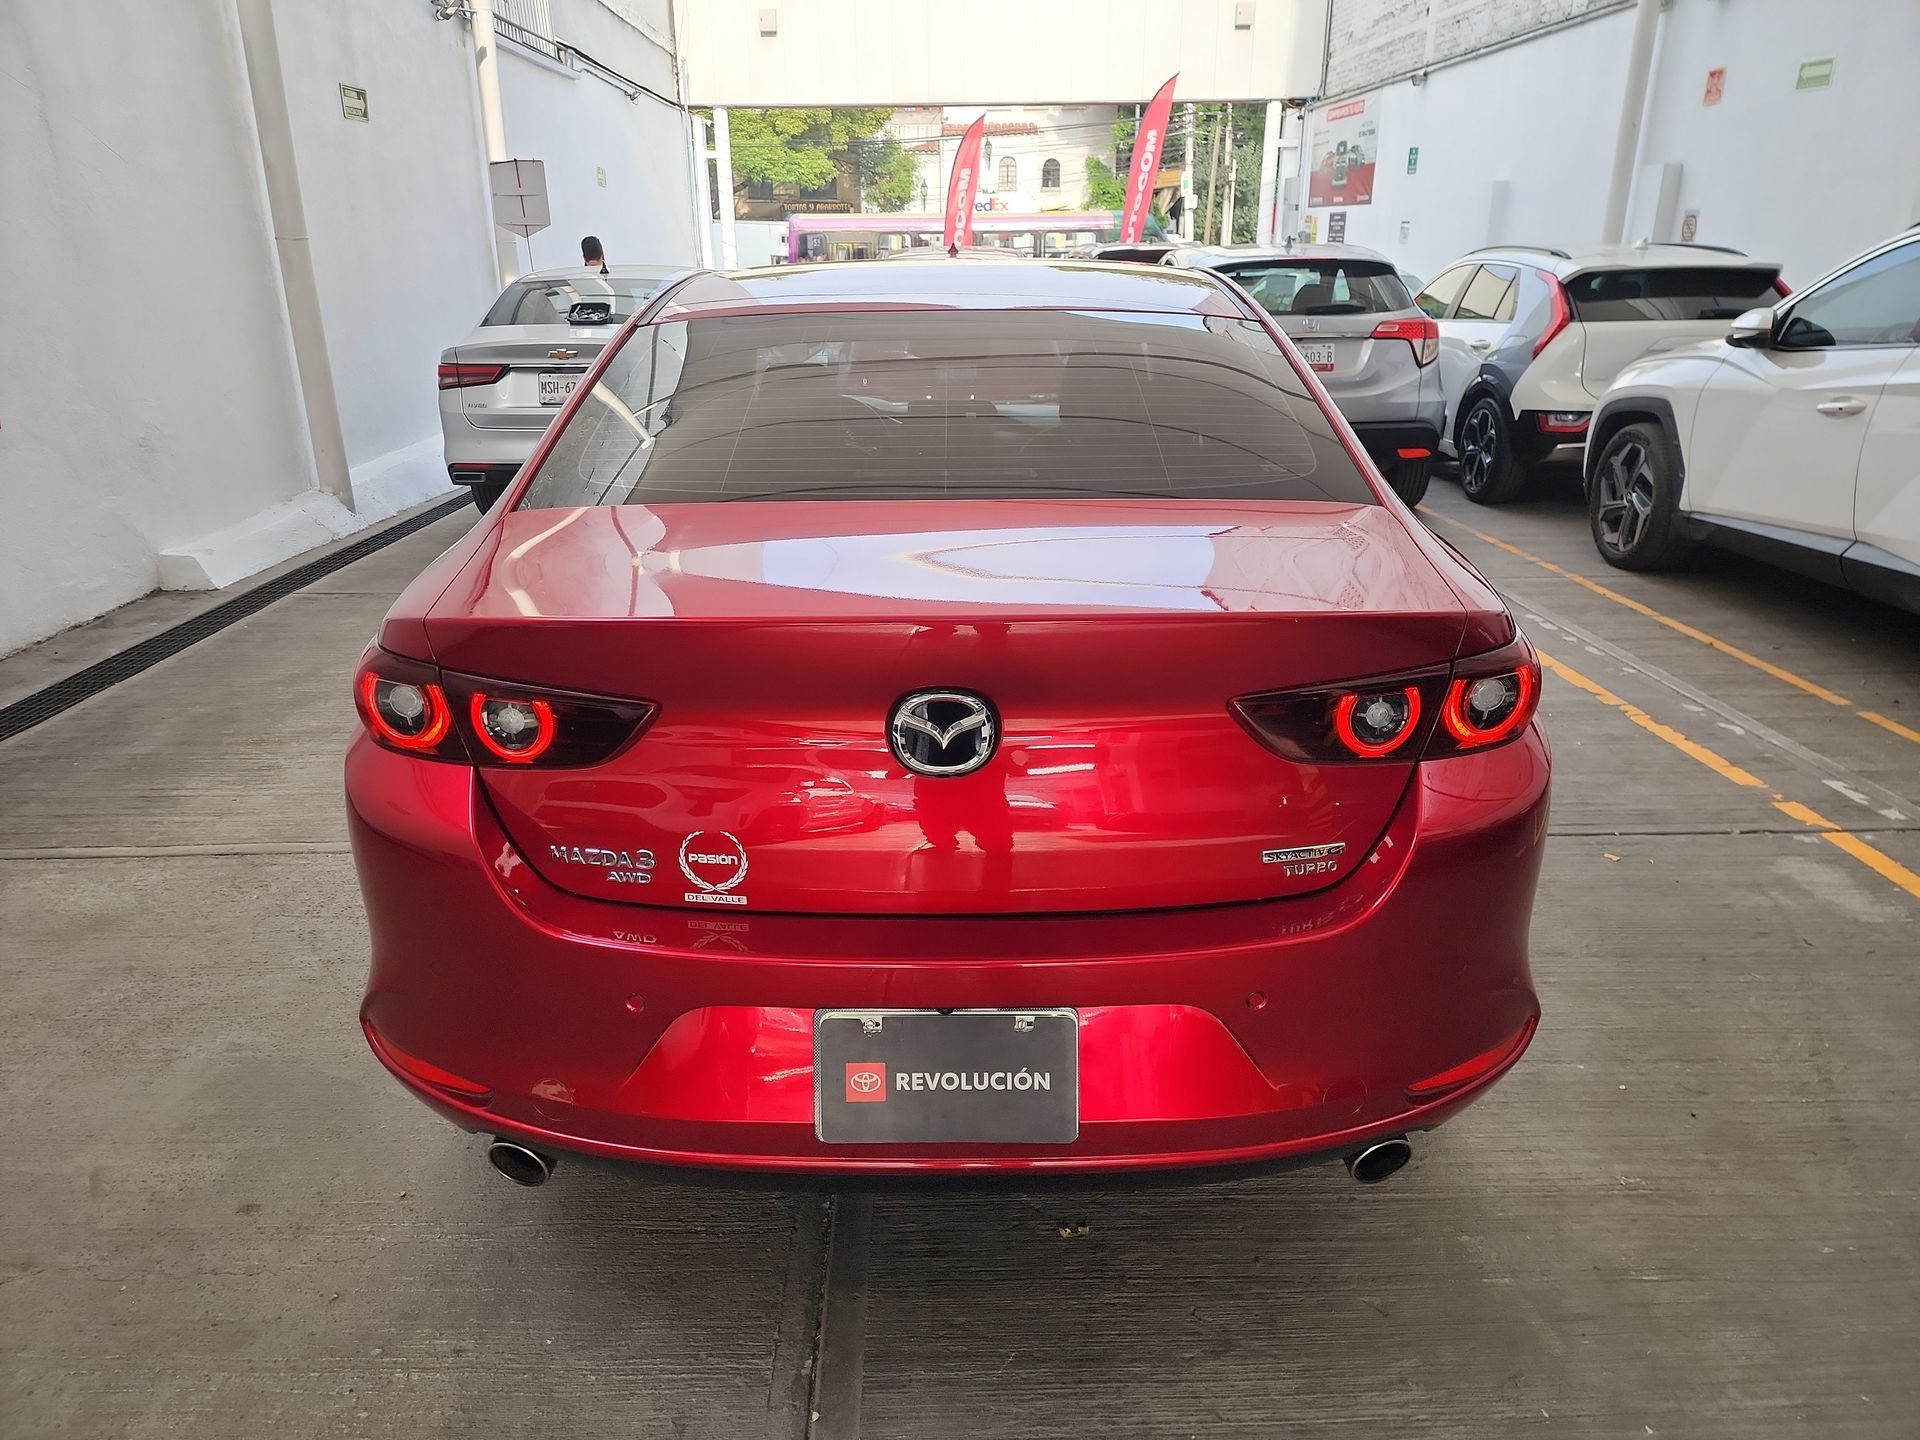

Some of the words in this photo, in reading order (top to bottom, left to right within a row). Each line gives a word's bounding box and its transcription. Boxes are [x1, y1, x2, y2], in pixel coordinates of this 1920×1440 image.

[973, 198, 1009, 212] edEx
[1283, 860, 1338, 877] TURBO
[606, 871, 652, 884] AWD
[711, 896, 746, 904] VALLE
[895, 1067, 1051, 1091] REVOLUCIÓN
